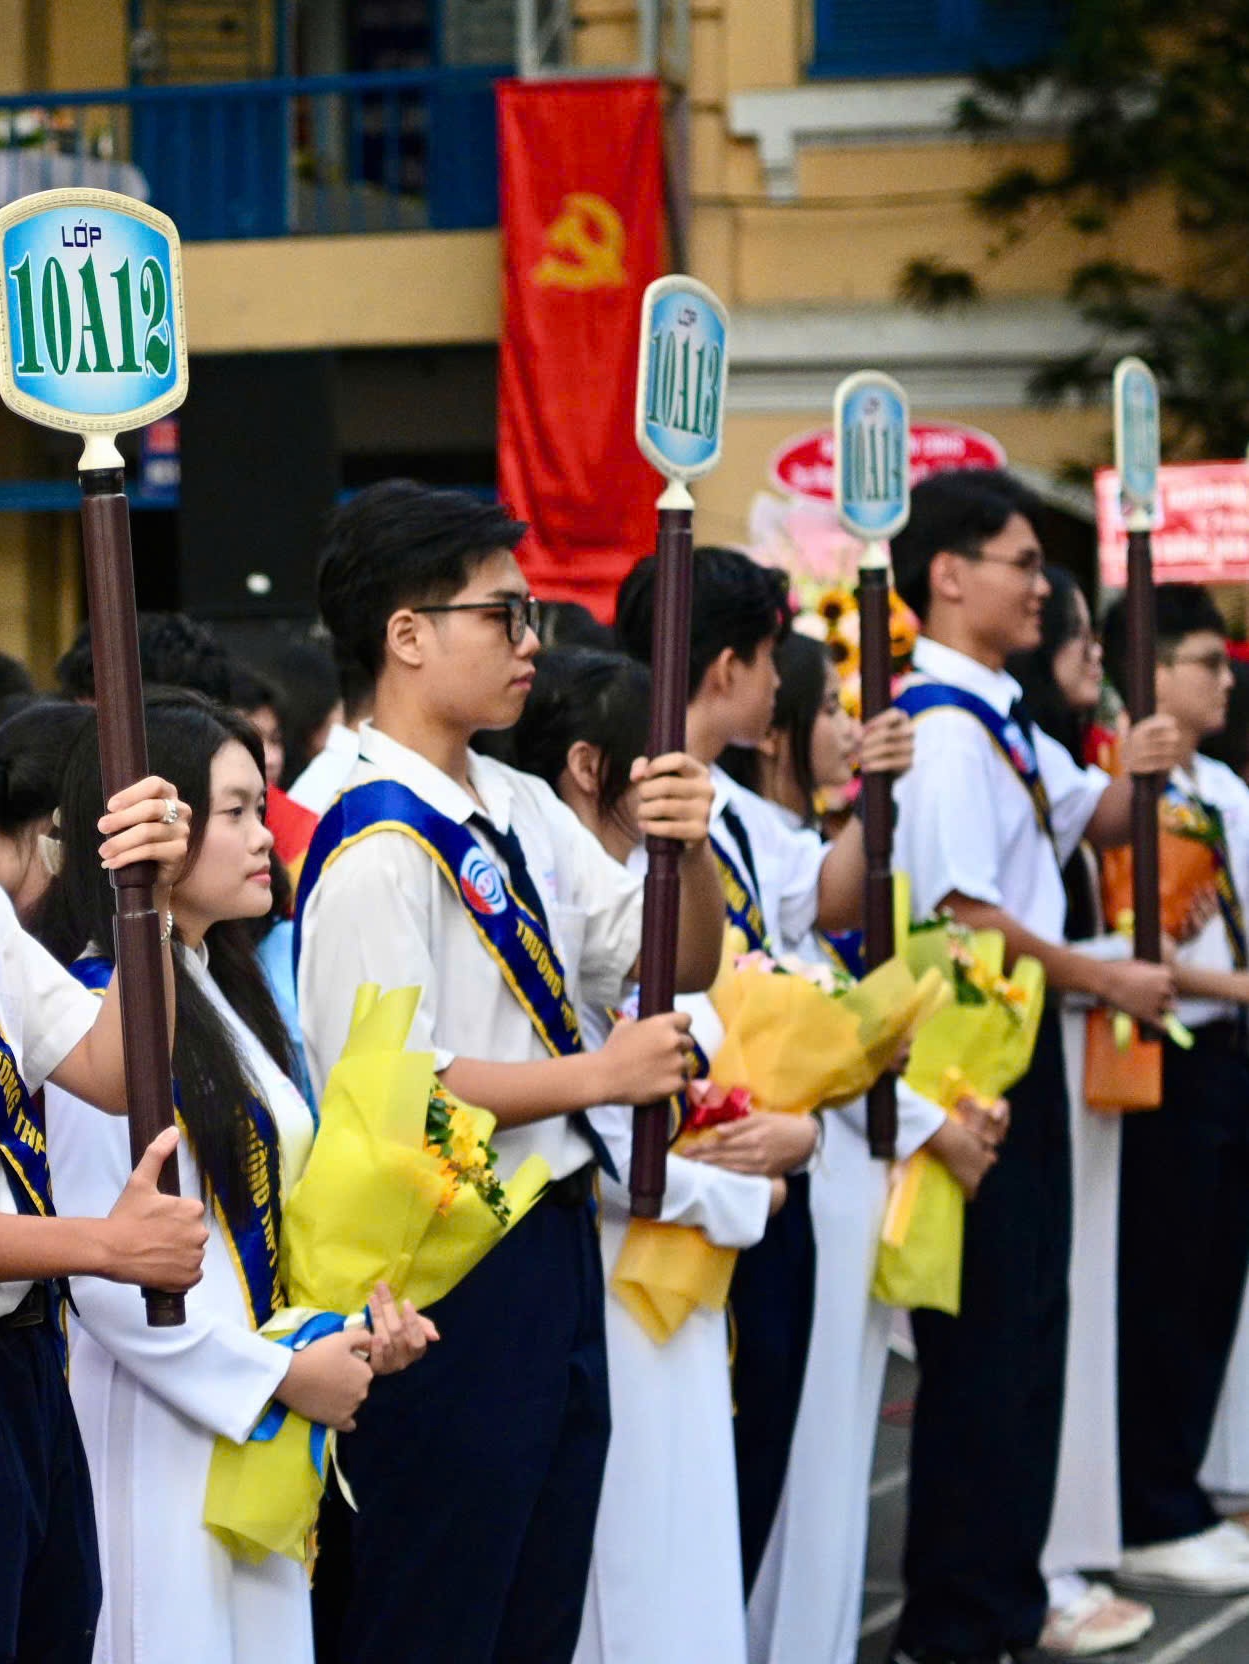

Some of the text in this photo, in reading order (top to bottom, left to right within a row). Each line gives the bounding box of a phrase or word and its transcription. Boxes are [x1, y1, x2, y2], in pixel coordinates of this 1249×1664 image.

[61, 219, 102, 248] LỚP
[10, 252, 171, 377] 10A12
[648, 330, 720, 440] 10A13
